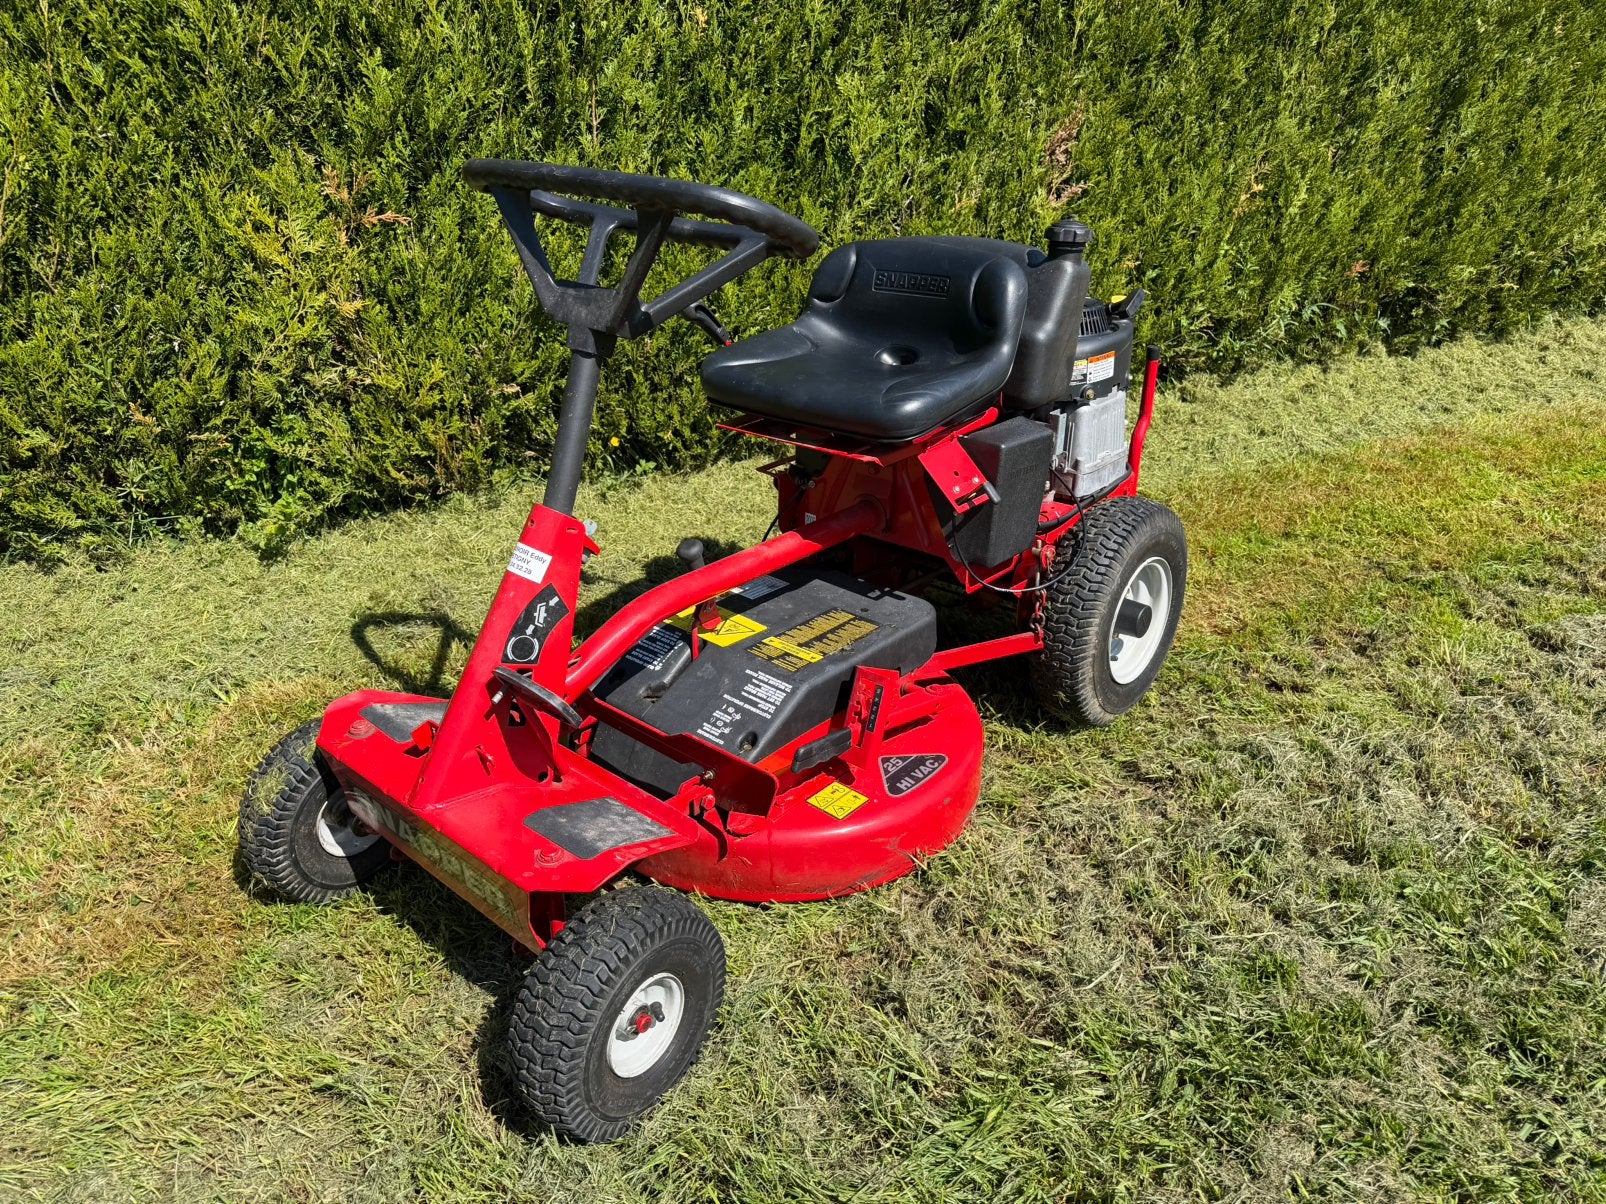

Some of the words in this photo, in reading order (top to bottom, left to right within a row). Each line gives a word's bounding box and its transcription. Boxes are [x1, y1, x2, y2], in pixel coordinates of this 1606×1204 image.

[875, 269, 950, 294] SNAPPER
[529, 552, 547, 564] Eddy
[884, 757, 903, 772] 25
[896, 777, 914, 791] HI
[914, 759, 939, 780] VAC
